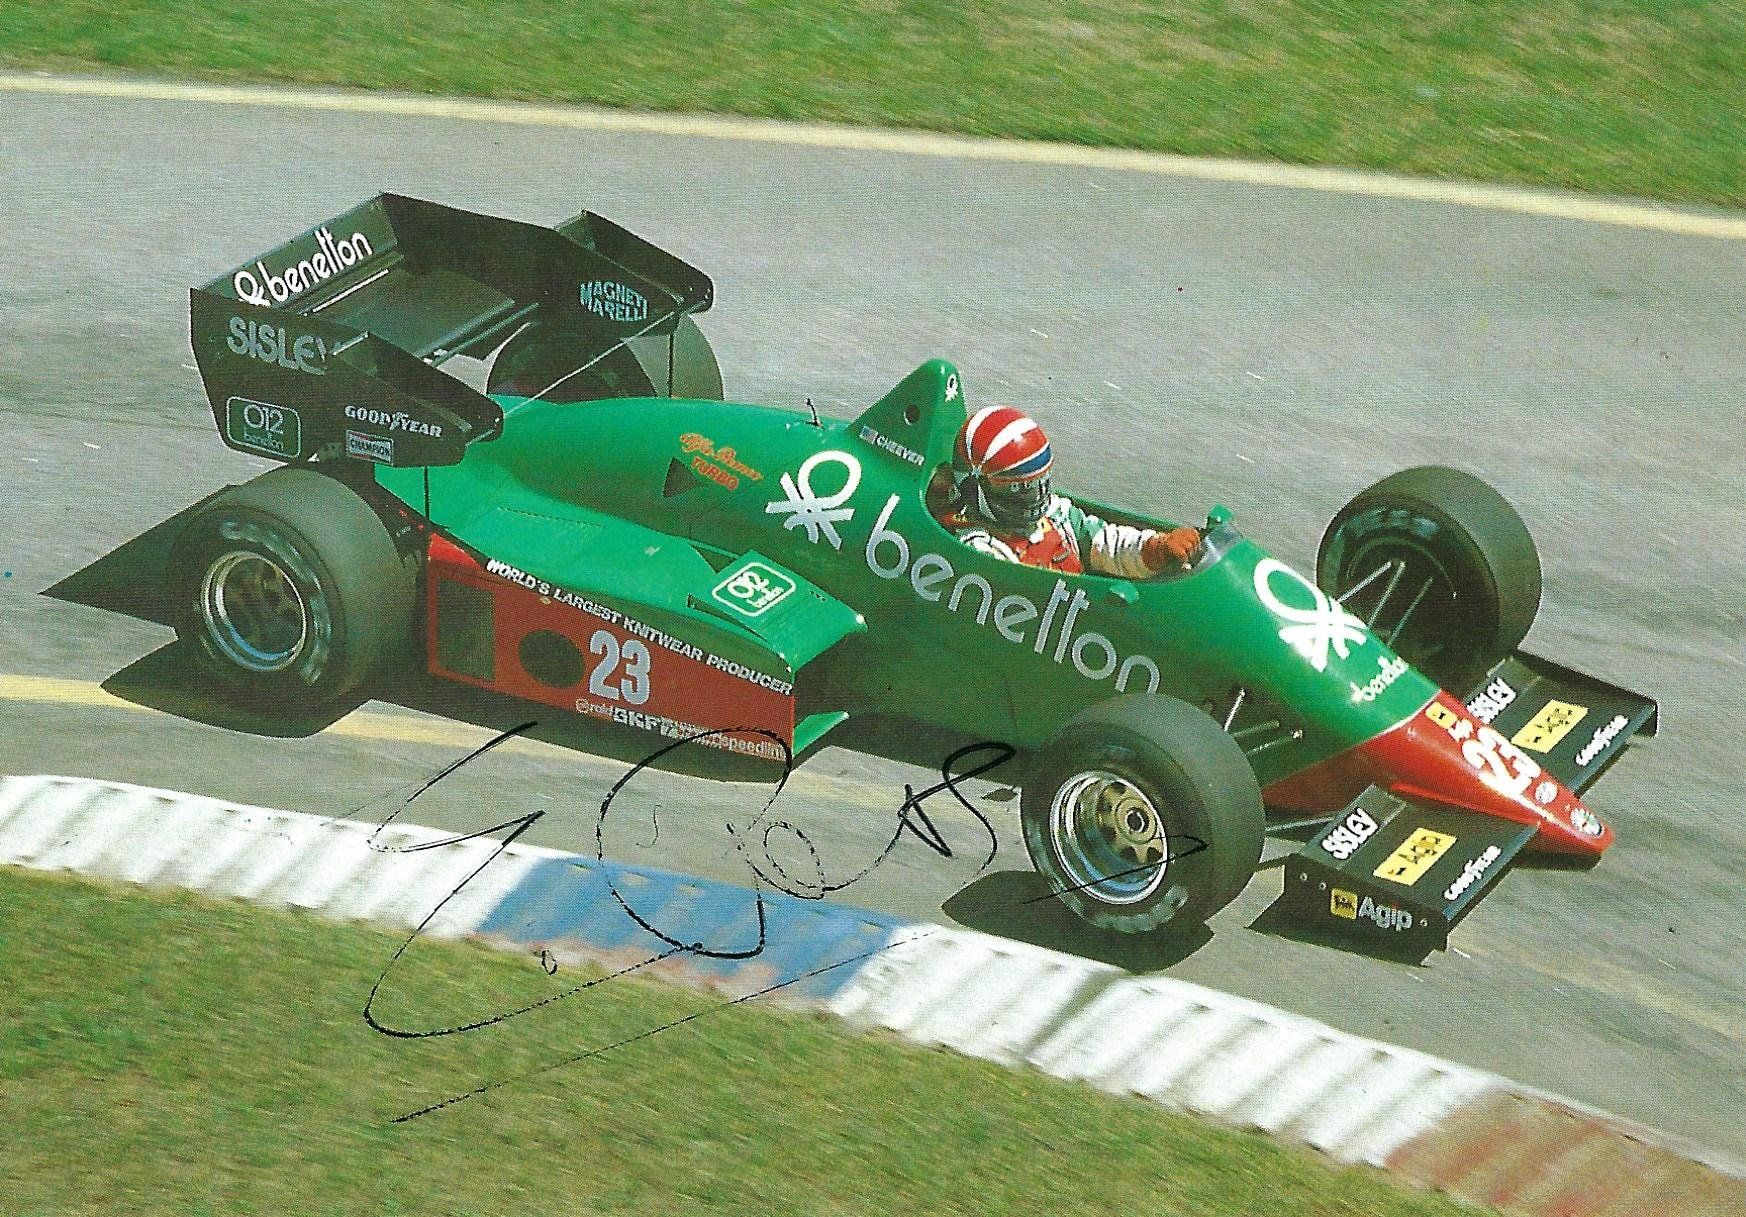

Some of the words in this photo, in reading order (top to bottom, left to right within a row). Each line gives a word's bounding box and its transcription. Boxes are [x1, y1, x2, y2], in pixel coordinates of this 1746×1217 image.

[256, 227, 373, 302] benetton
[691, 456, 739, 490] TURBO
[877, 436, 925, 466] CHEEVER
[486, 559, 550, 596] WORLD'S
[553, 587, 621, 624] LARGEST
[623, 616, 703, 661] KNITWEAR
[706, 655, 794, 696] PRODUCER
[865, 493, 1159, 695] benetton
[588, 630, 651, 705] 23
[1462, 726, 1541, 797] 23
[1358, 896, 1413, 932] Agip
